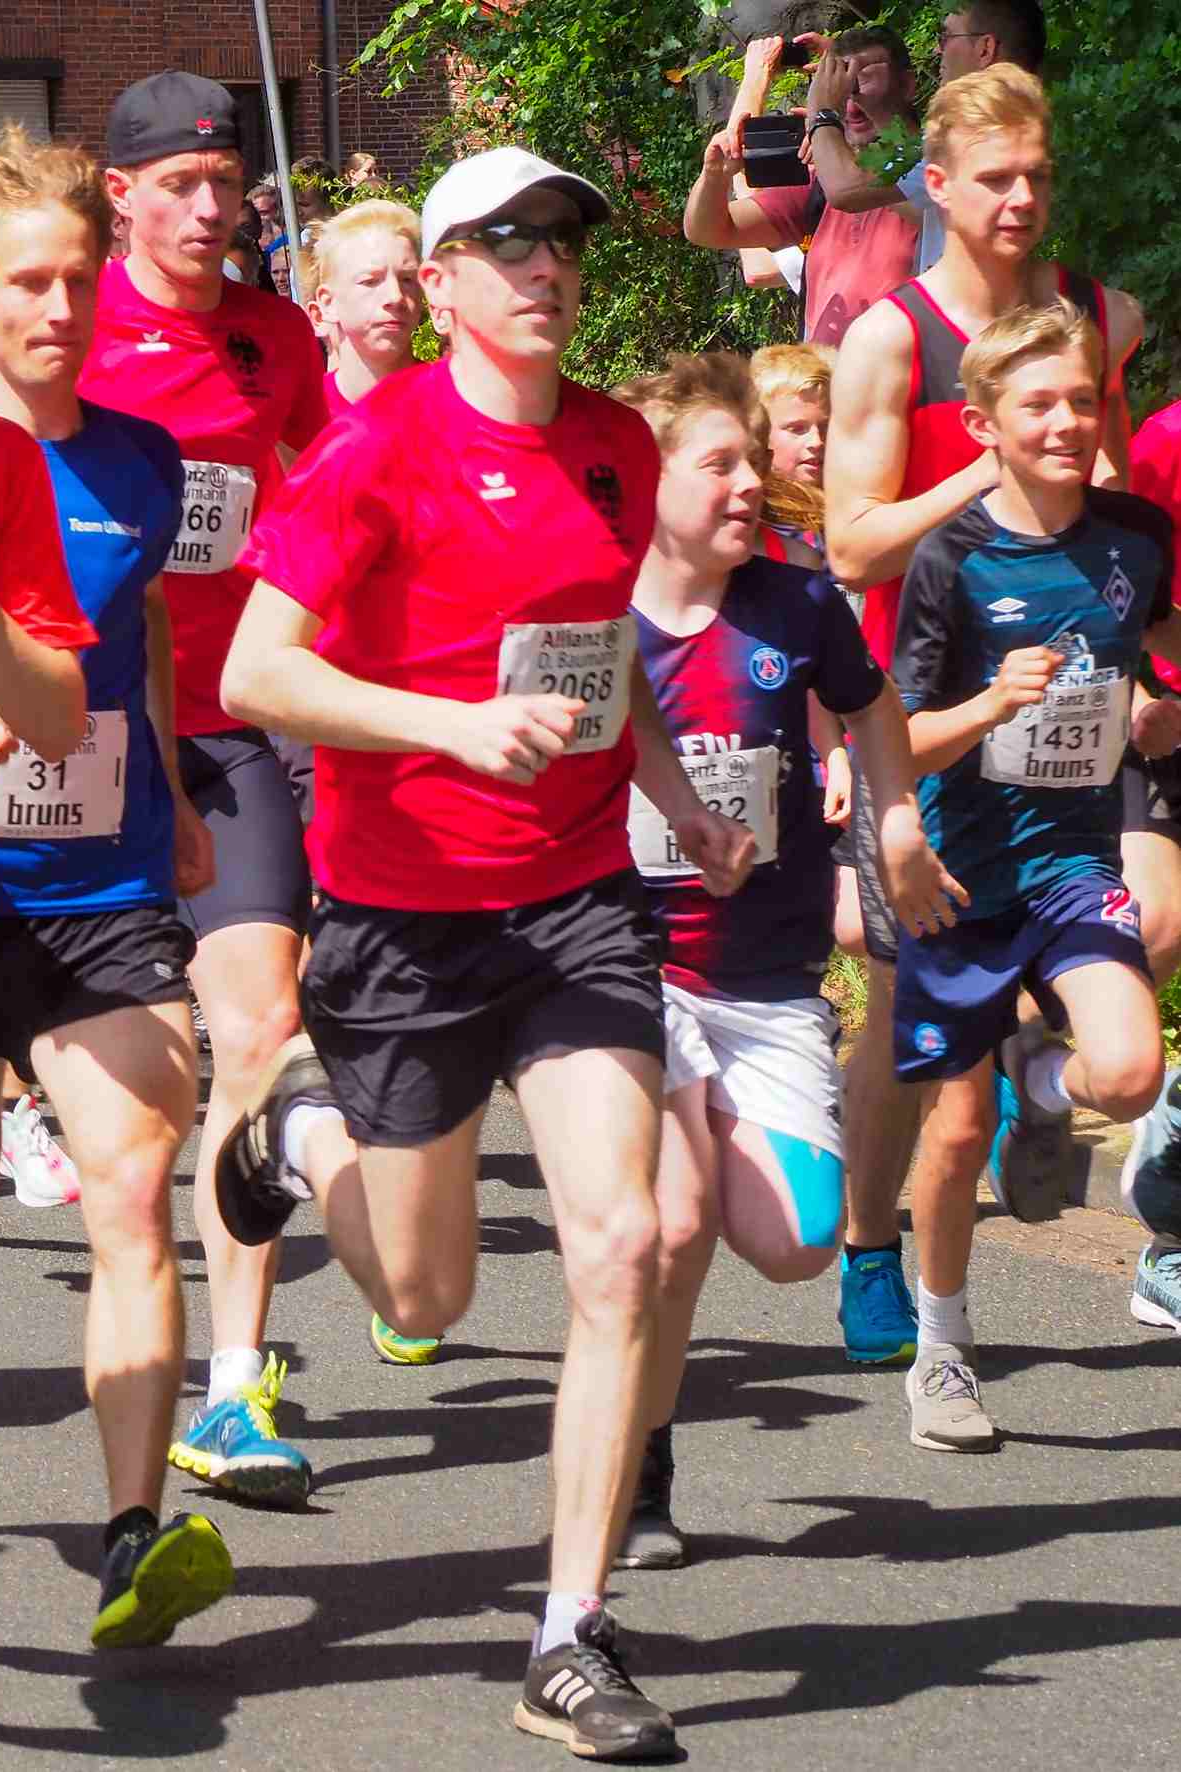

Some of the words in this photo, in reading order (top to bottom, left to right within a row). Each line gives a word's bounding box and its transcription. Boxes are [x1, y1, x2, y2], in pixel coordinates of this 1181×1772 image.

[187, 504, 222, 533] 66
[173, 541, 212, 564] uns
[540, 629, 601, 649] Allianz
[539, 668, 614, 703] 2068
[1025, 723, 1102, 750] 1431
[26, 760, 67, 791] 31
[1025, 752, 1096, 779] bruns
[7, 794, 84, 826] bruns
